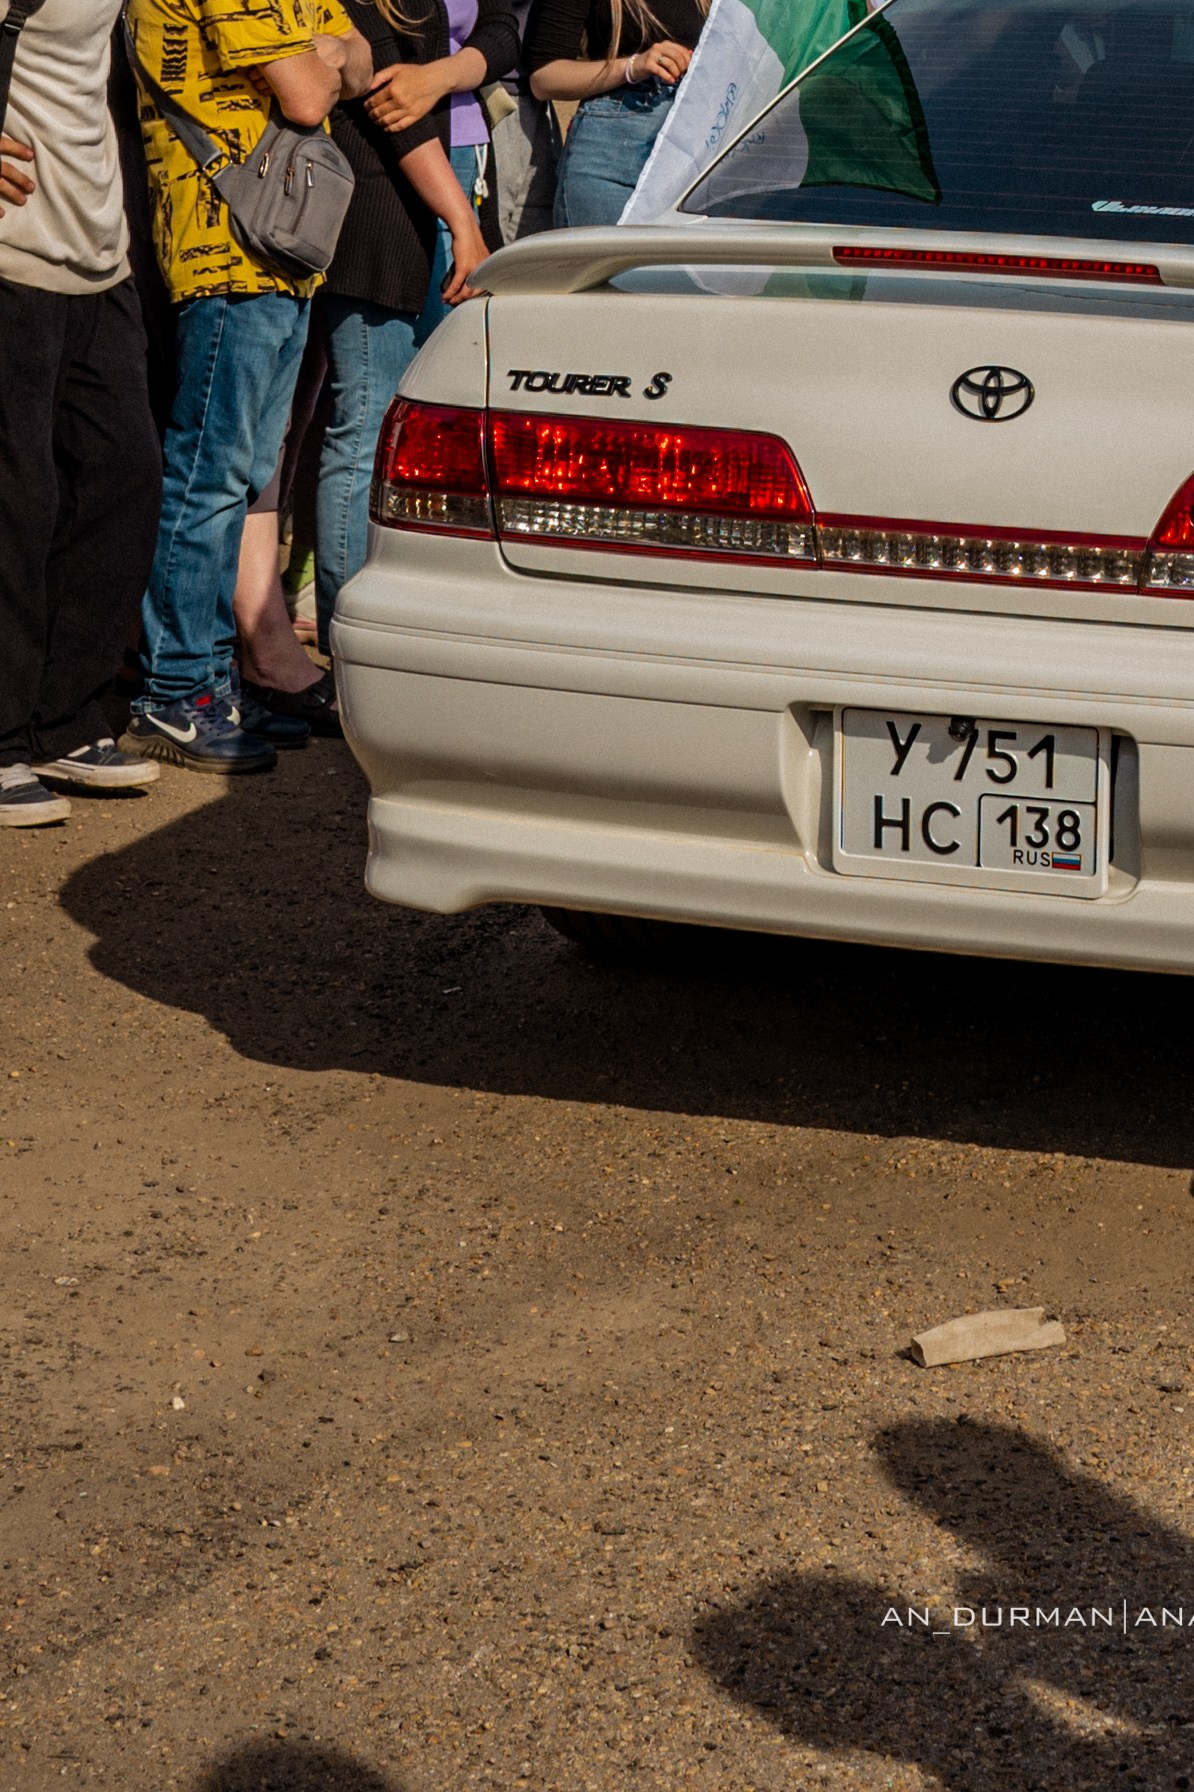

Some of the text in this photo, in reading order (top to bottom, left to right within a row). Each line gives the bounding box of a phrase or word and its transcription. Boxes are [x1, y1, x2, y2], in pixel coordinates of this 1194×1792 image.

[507, 369, 673, 400] TOURER S
[952, 727, 1056, 789] 751
[995, 803, 1082, 852] 138
[1012, 849, 1052, 868] RUS
